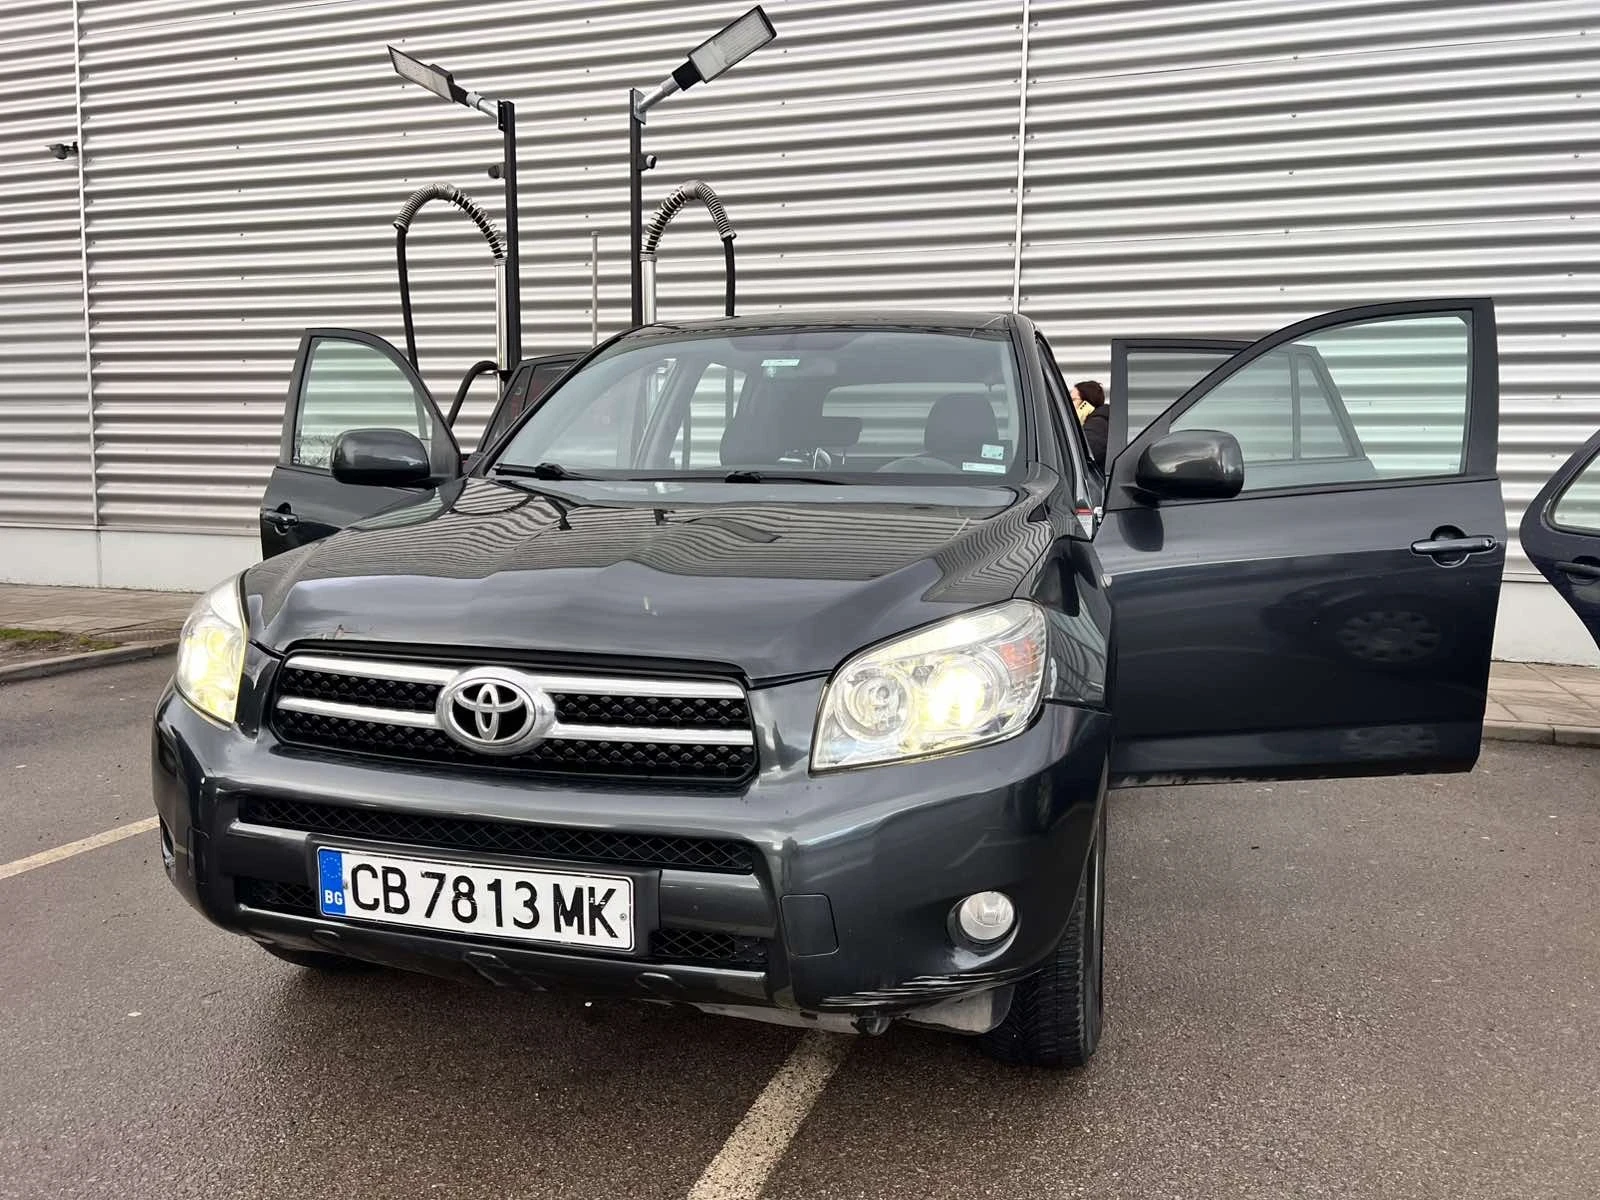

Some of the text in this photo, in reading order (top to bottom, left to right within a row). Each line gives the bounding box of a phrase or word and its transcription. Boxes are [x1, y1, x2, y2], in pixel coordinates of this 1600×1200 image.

[325, 889, 343, 906] BG
[351, 864, 618, 938] CB 7813 MK
